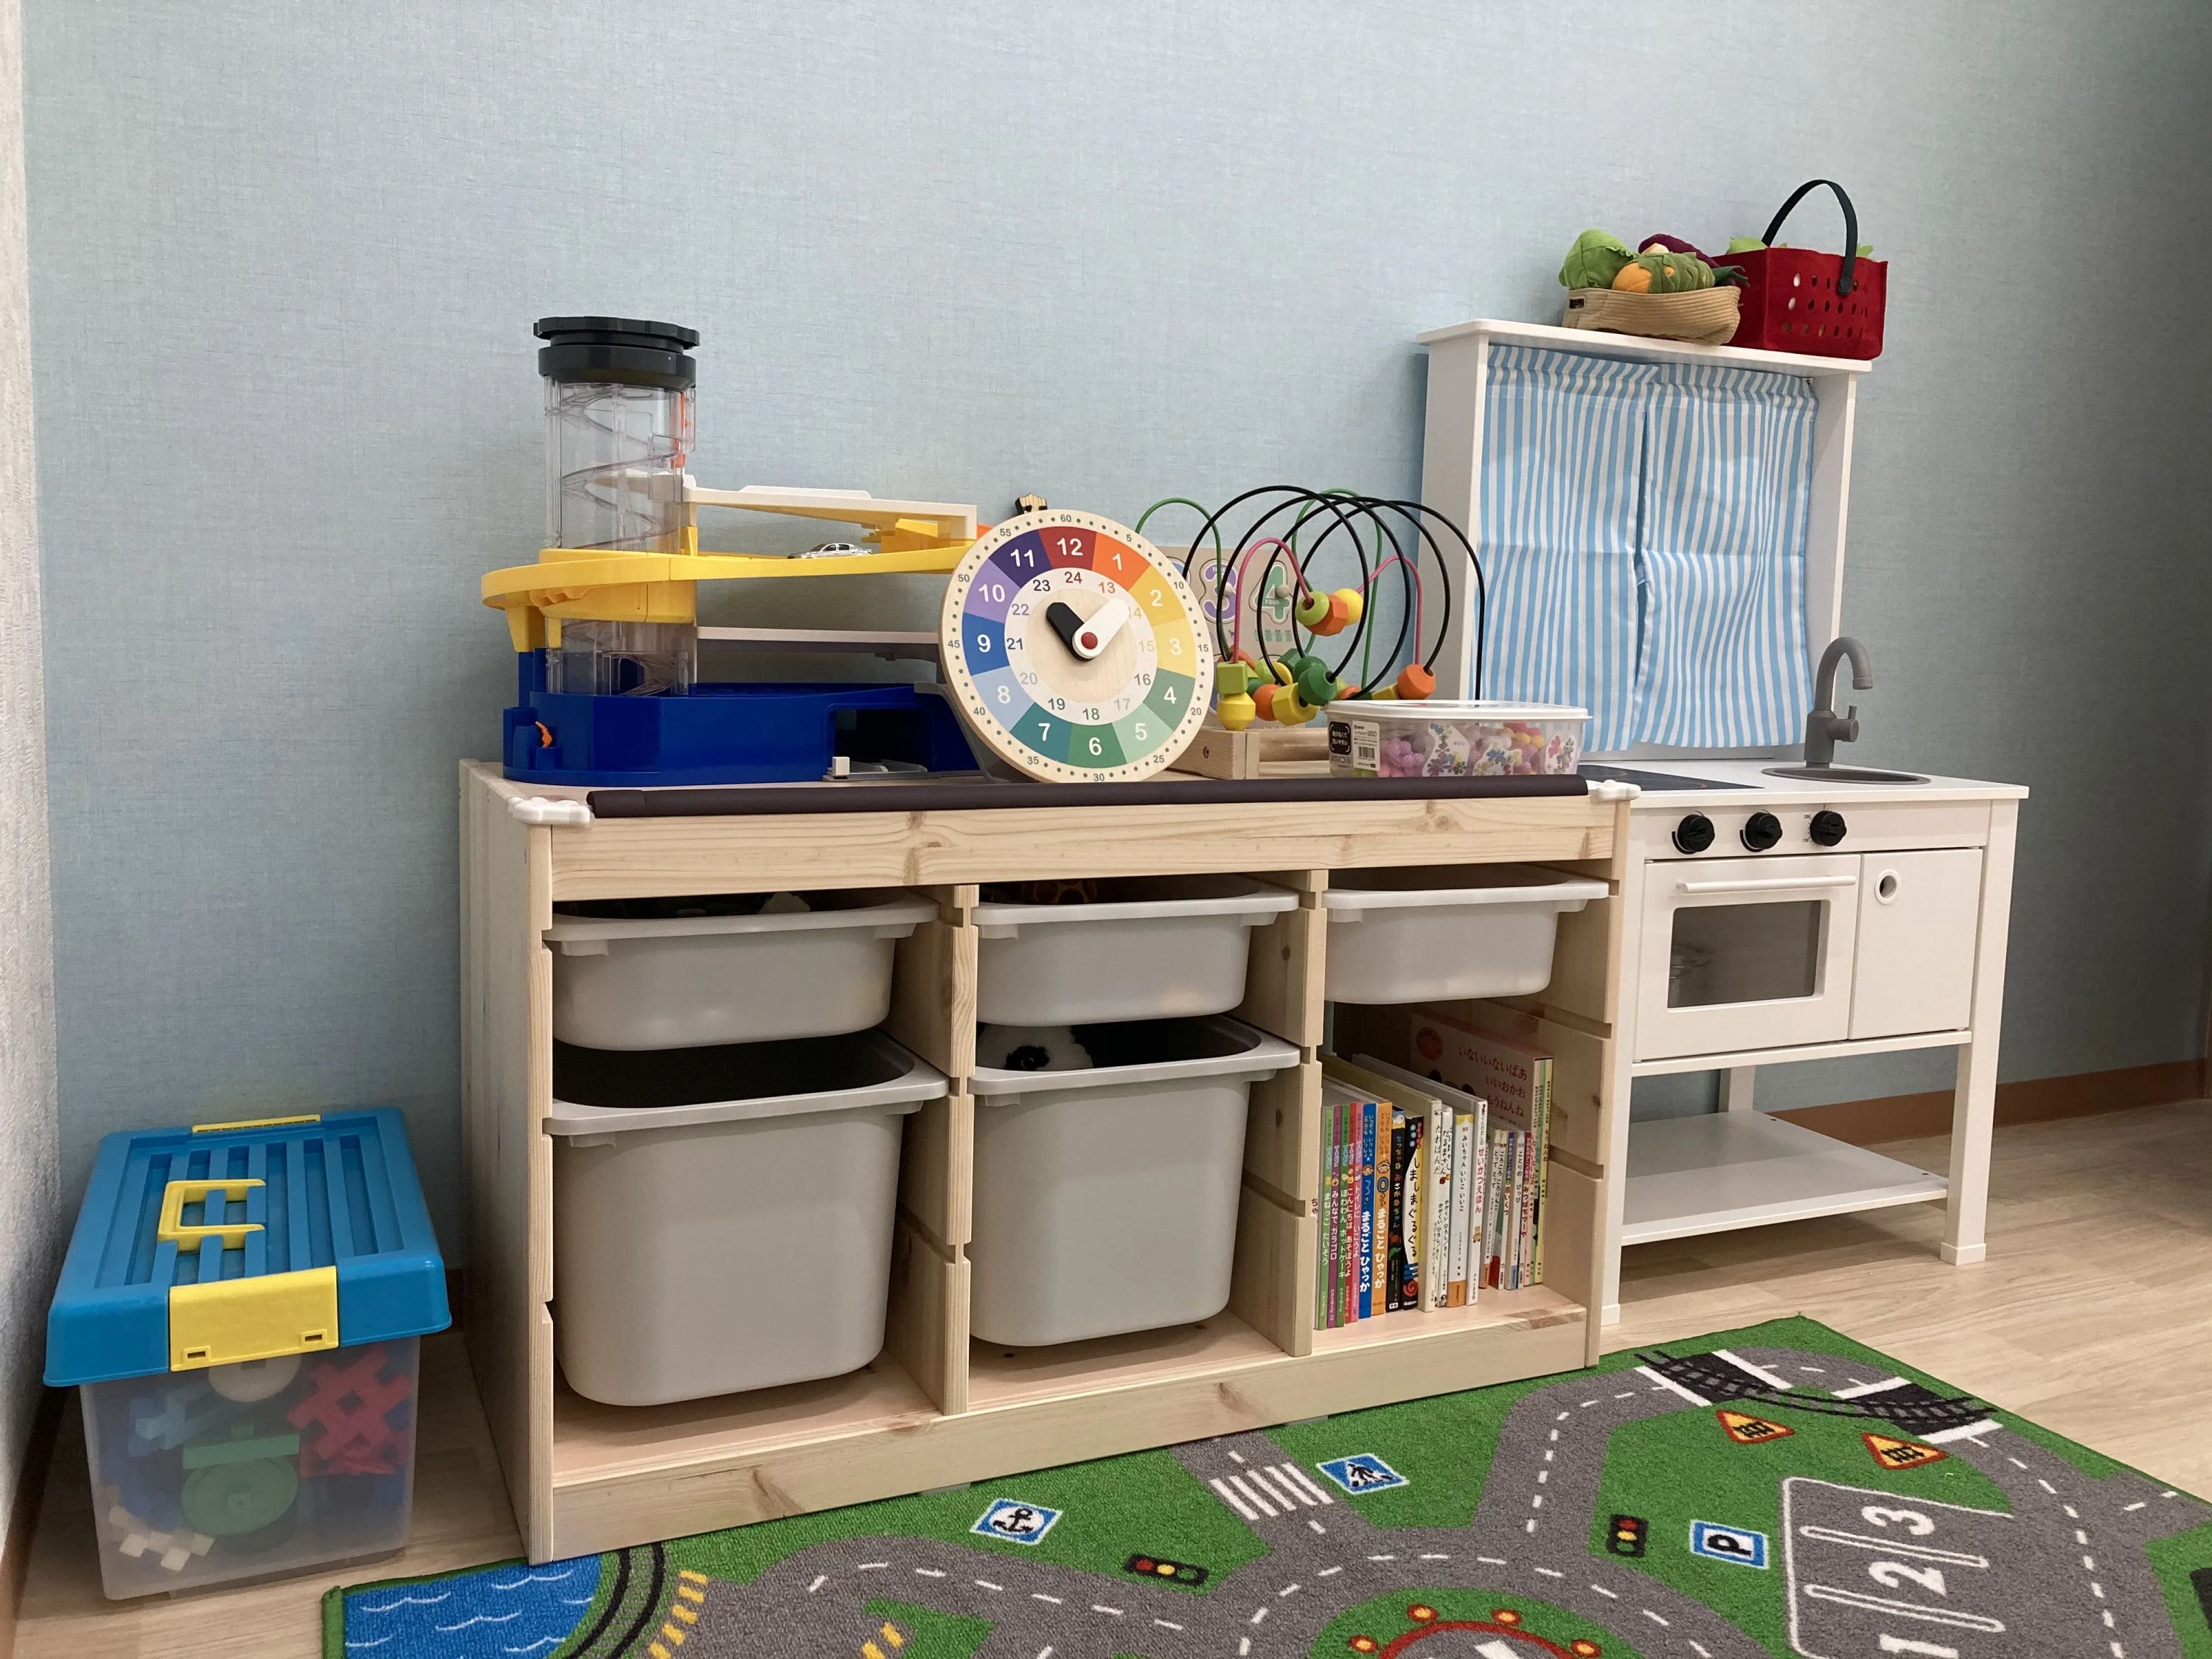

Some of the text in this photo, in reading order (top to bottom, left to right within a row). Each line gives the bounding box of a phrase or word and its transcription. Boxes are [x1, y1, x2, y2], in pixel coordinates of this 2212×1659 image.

[1060, 515, 1072, 523] 60
[999, 528, 1012, 537] 55
[1126, 534, 1132, 542] 5
[1057, 538, 1083, 557] 12
[1010, 549, 1034, 568] 11
[1112, 554, 1122, 571] 1
[958, 574, 970, 582] 50
[1032, 579, 1051, 591] 23
[1064, 571, 1082, 584] 24
[1173, 582, 1184, 590] 10
[978, 584, 1005, 602] 10
[1098, 582, 1116, 594] 13
[1253, 565, 1290, 621] 4
[1150, 590, 1164, 607] 2
[1011, 604, 1029, 616] 22
[947, 640, 959, 648] 45
[977, 634, 991, 653] 9
[1006, 638, 1023, 650] 21
[1138, 641, 1155, 653] 15
[1169, 638, 1182, 655] 3
[1020, 672, 1037, 685] 20
[1134, 673, 1151, 686] 16
[998, 686, 1011, 703] 8
[1164, 686, 1177, 704] 4
[973, 707, 985, 715] 40
[1048, 698, 1065, 710] 19
[1113, 698, 1130, 711] 17
[1082, 708, 1100, 720] 18
[1038, 723, 1051, 741] 7
[1135, 723, 1147, 740] 5
[1088, 737, 1102, 756] 6
[1027, 757, 1040, 765] 35
[1153, 755, 1164, 763] 25
[1093, 773, 1105, 782] 30
[1458, 1046, 1527, 1081] いないいないばあ
[1486, 1076, 1526, 1099] いいおかお
[1486, 1094, 1524, 1117] もうねんね
[1475, 1149, 1484, 1213] せいかつえほん
[1408, 1157, 1420, 1257] しましまぐるぐる
[1361, 1211, 1371, 1253] まるごと
[1377, 1208, 1386, 1250] まるごと
[1360, 1256, 1371, 1292] ひゃっか
[1374, 1253, 1385, 1289] ひゃっか
[1862, 1506, 1935, 1535] 3
[1708, 1534, 1752, 1559] P
[1868, 1561, 1947, 1596] 2
[1879, 1633, 1959, 1659] 1
